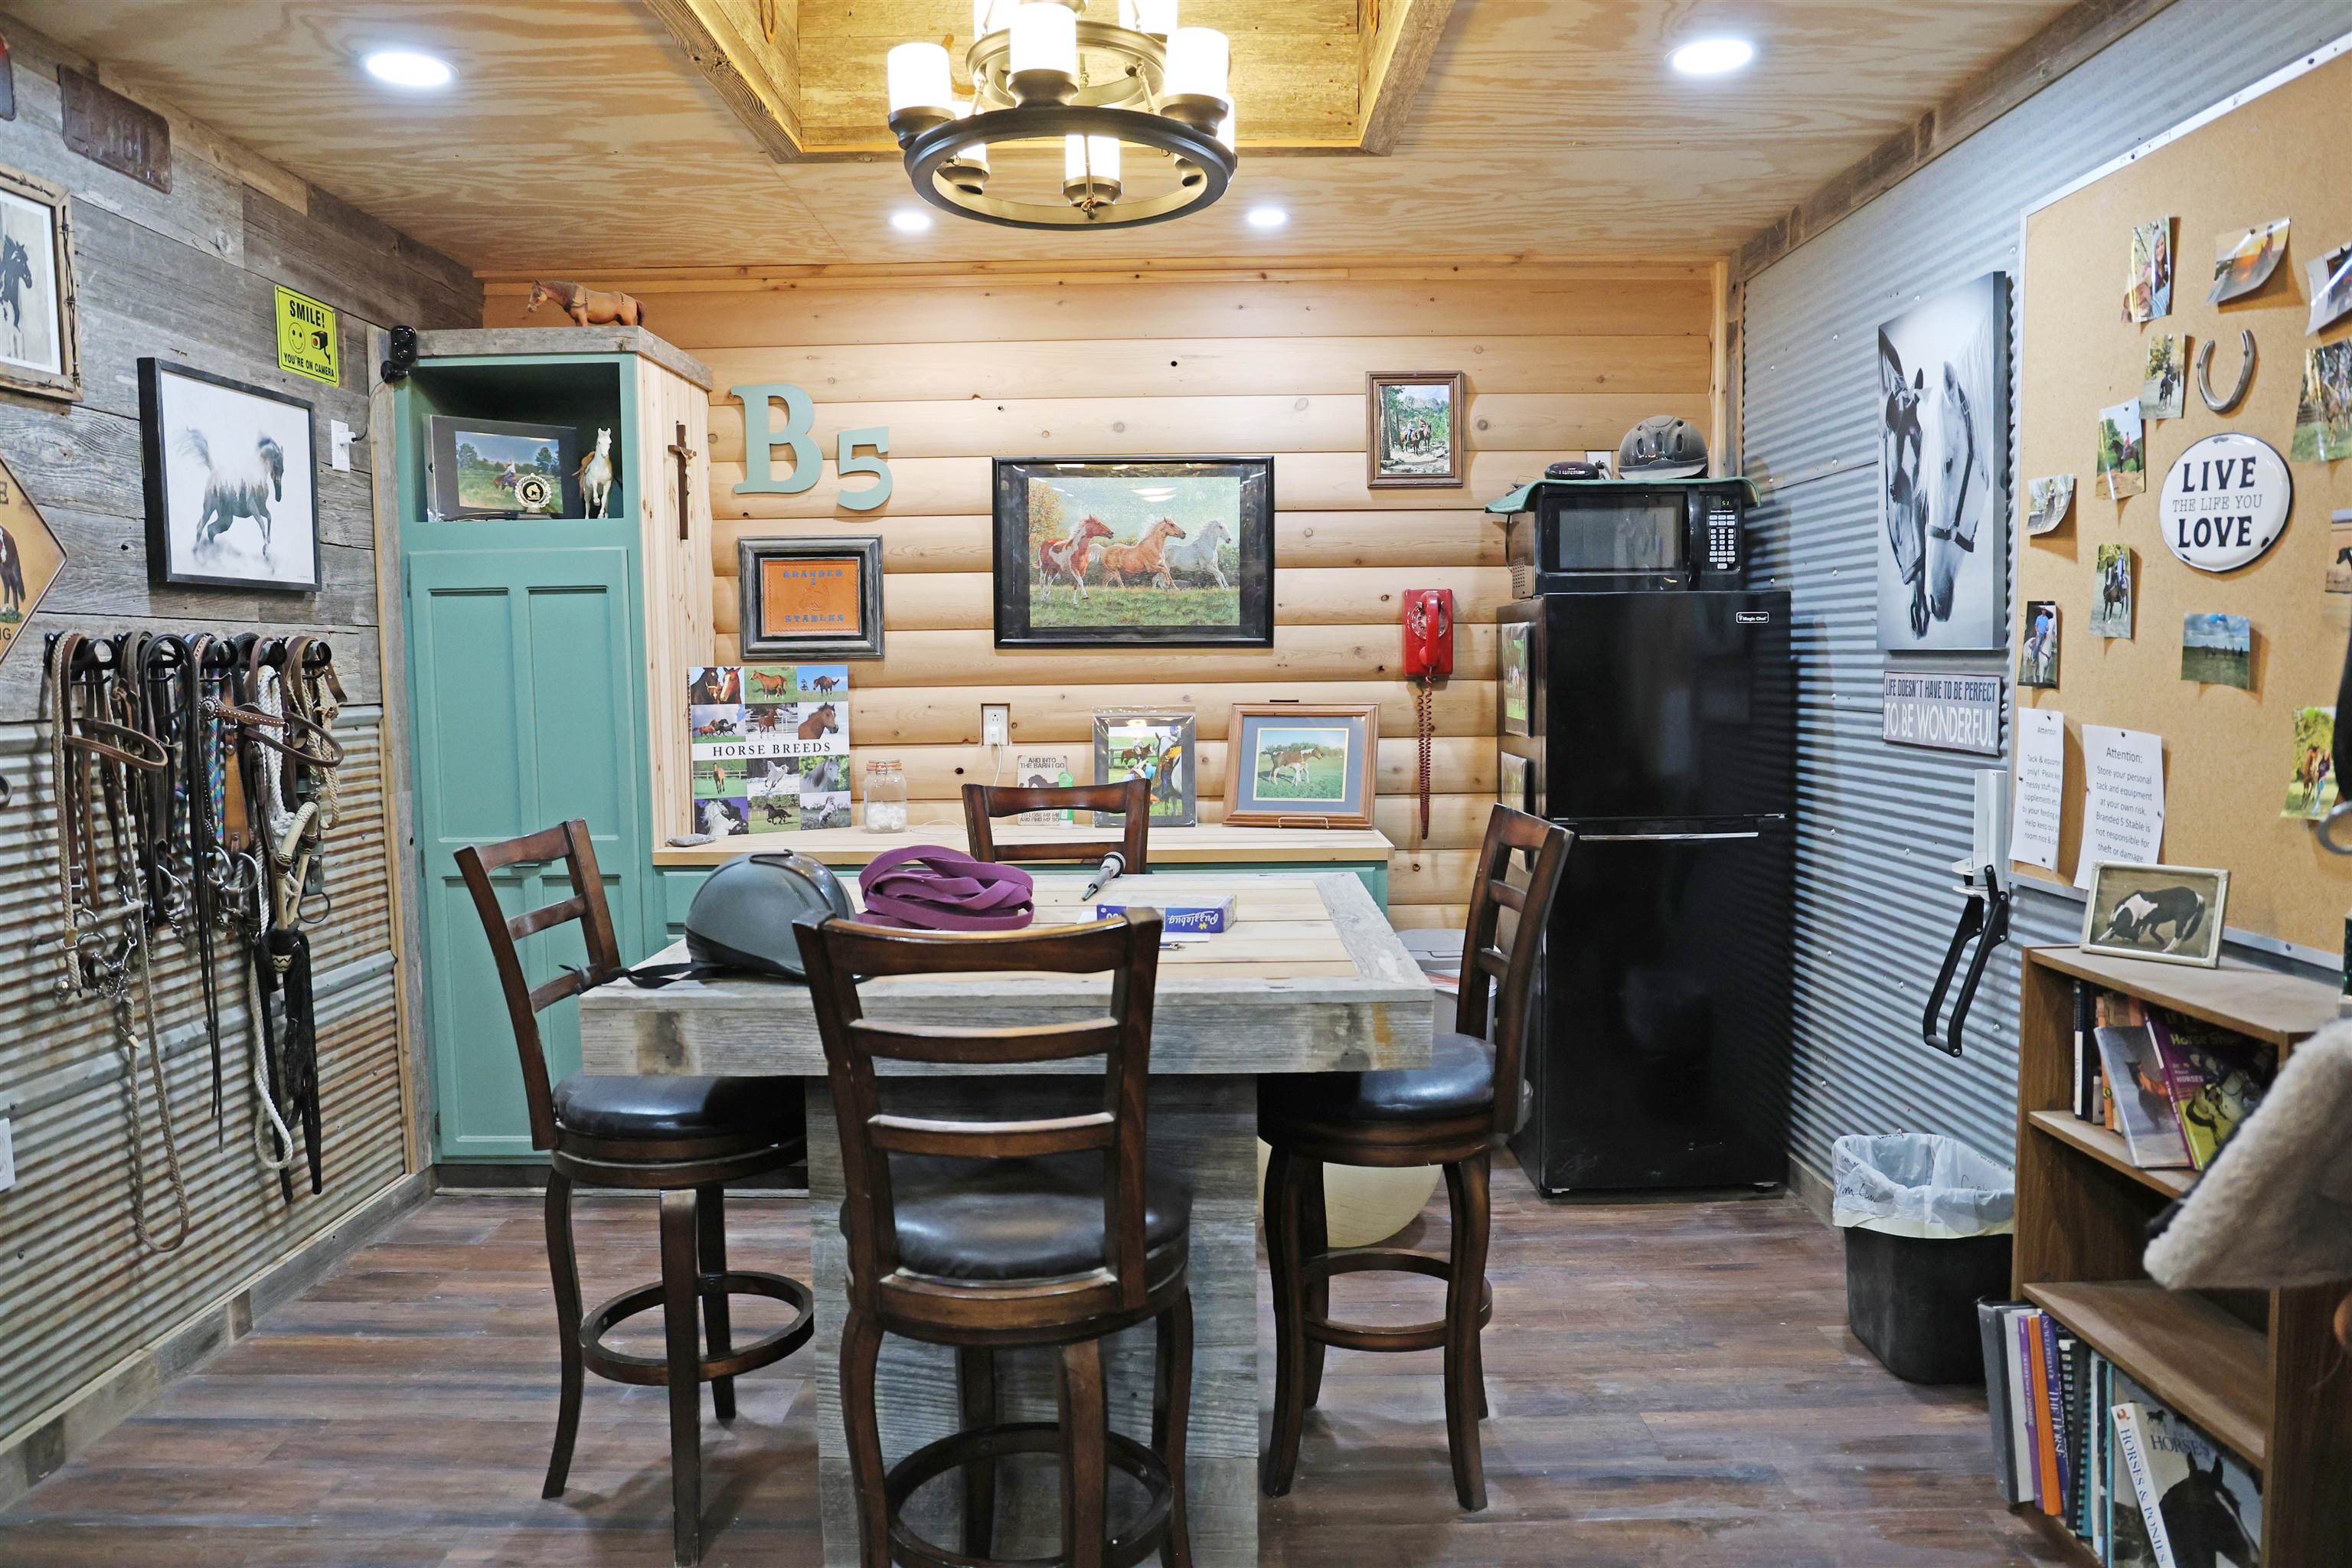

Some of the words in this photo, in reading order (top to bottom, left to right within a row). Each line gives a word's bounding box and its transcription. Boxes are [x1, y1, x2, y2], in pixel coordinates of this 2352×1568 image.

[289, 299, 325, 328] SMILE!
[283, 352, 304, 368] YOU'RE
[306, 360, 313, 370] ON
[315, 363, 335, 377] CAMERA
[2182, 456, 2256, 492] LIVE
[2173, 498, 2195, 512] THE
[2200, 496, 2230, 511] LIFE
[2235, 494, 2262, 509] YOU
[2178, 515, 2252, 548] LOVE
[1886, 678, 1896, 697] LIFE
[1925, 681, 1942, 699] HAVE
[1944, 681, 1952, 700] TO
[1954, 681, 1962, 701] BE
[1965, 681, 1997, 702] PERFECT
[1885, 702, 1899, 737] TO
[1901, 703, 1914, 738] BE
[1916, 704, 1994, 748] WONDERFUL
[713, 744, 765, 756] HORSE
[773, 742, 831, 754] BREEDS
[2106, 747, 2143, 764] Attention:
[2097, 766, 2112, 776] Store
[2113, 771, 2125, 779] your
[2127, 773, 2151, 784] personal
[2096, 782, 2108, 790] tack
[2109, 785, 2119, 793] and
[2120, 787, 2152, 801] equipment
[2120, 803, 2134, 812] own
[2025, 819, 2037, 828] Help
[2096, 812, 2119, 825] Branded
[2121, 817, 2125, 826] 5
[2125, 818, 2145, 831] Stable
[2024, 832, 2037, 841] room
[2096, 828, 2105, 837] not
[2106, 831, 2140, 845] responsible
[2141, 838, 2150, 848] for
[2098, 843, 2112, 854] theft
[1168, 910, 1219, 928] Puzzlebug
[2176, 1075, 2204, 1083] HORSES
[2151, 1435, 2210, 1457] HORSES
[2121, 1429, 2144, 1486] HORSES
[2139, 1490, 2148, 1503] &
[2144, 1506, 2166, 1563] PONIES
